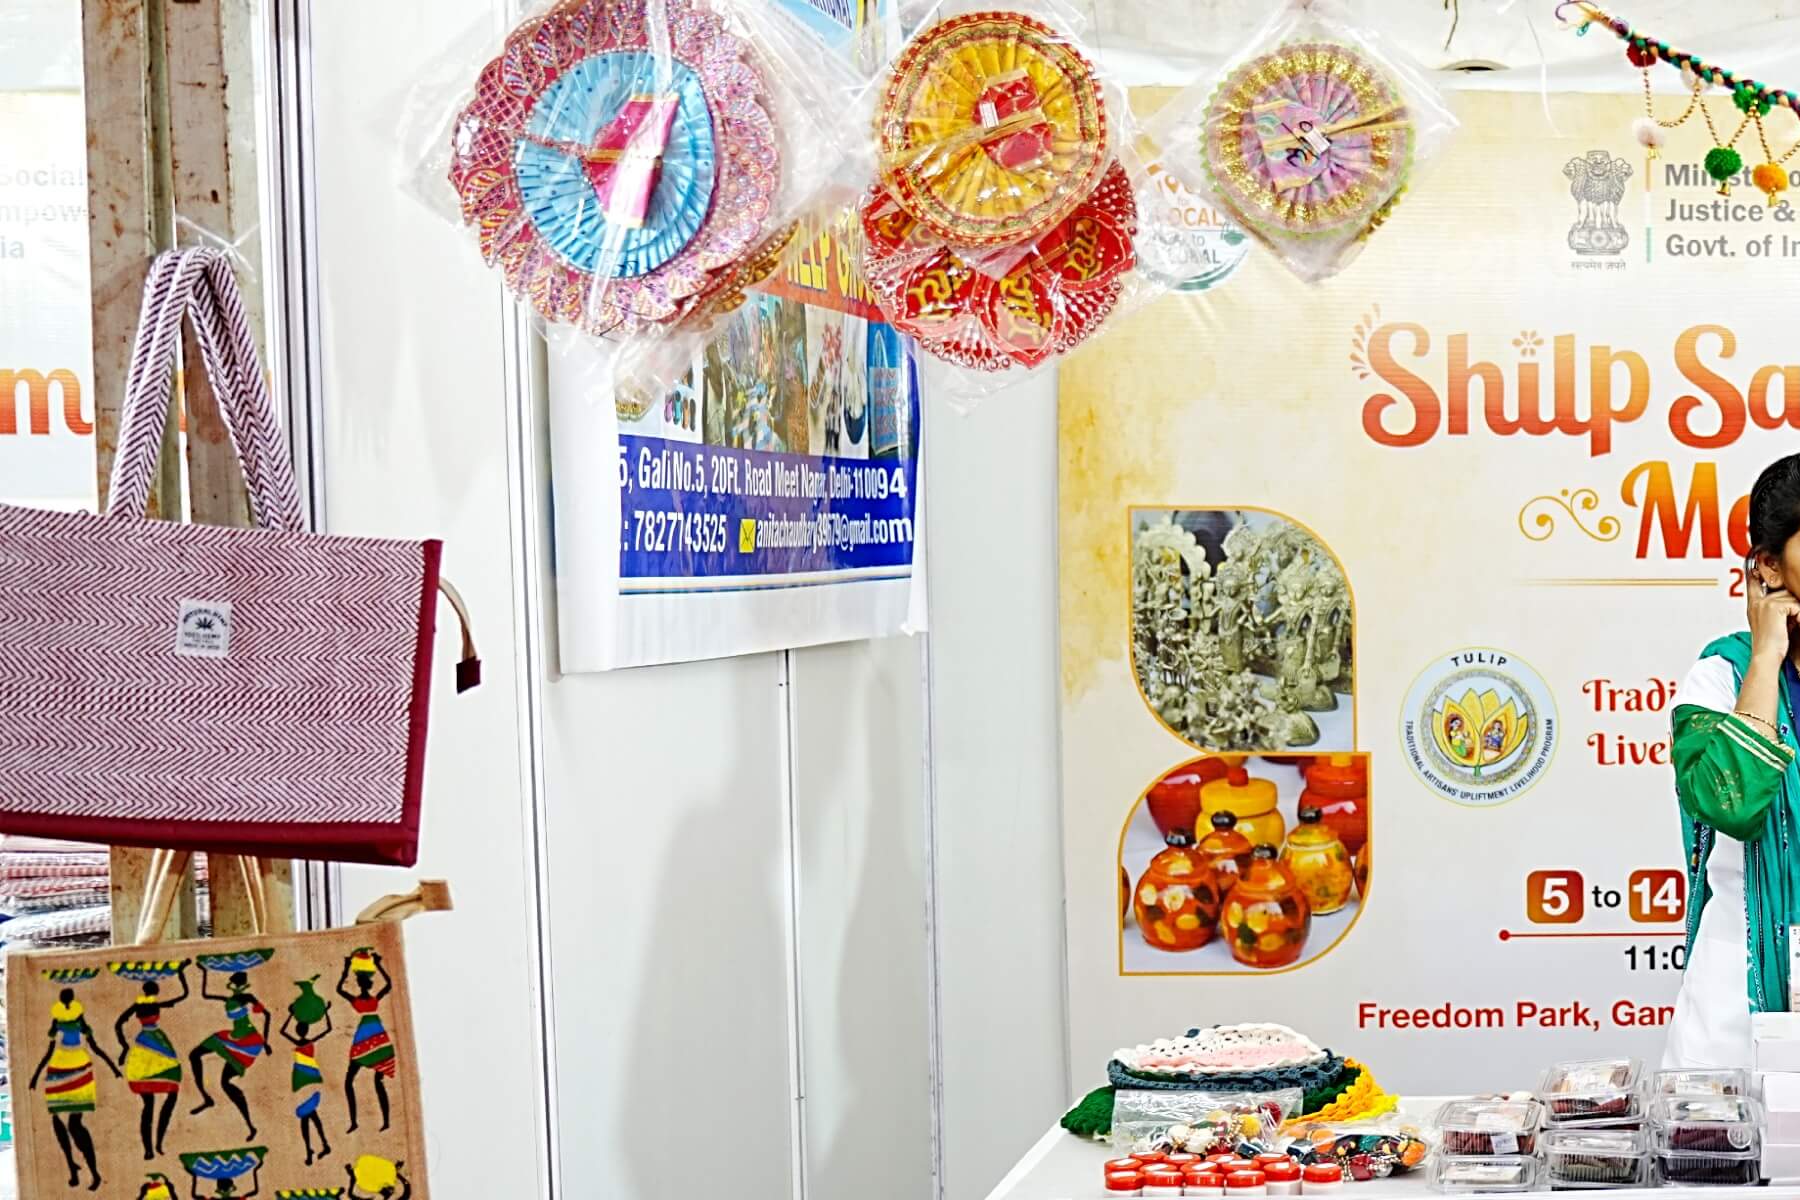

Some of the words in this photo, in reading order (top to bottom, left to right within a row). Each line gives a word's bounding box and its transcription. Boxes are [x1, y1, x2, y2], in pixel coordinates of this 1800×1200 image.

[1665, 163, 1784, 190] Minst
[1665, 198, 1764, 222] Justice
[1774, 199, 1796, 222] &
[1665, 233, 1736, 257] Govt.
[1746, 234, 1772, 257] of
[1361, 321, 1651, 458] Shilp
[638, 446, 671, 489] Gali
[745, 458, 772, 497] Road
[775, 460, 800, 499] Meet
[634, 510, 727, 553] 7827743525
[1450, 652, 1508, 667] TULIP
[1582, 677, 1677, 713] Tradi
[1541, 877, 1570, 917] 5
[1592, 885, 1622, 909] to
[1632, 876, 1682, 916] 14
[1624, 944, 1688, 971] 11:0
[1358, 1002, 1505, 1029] Freedom
[1516, 1001, 1600, 1032] Park,
[1611, 1000, 1675, 1026] Gan
